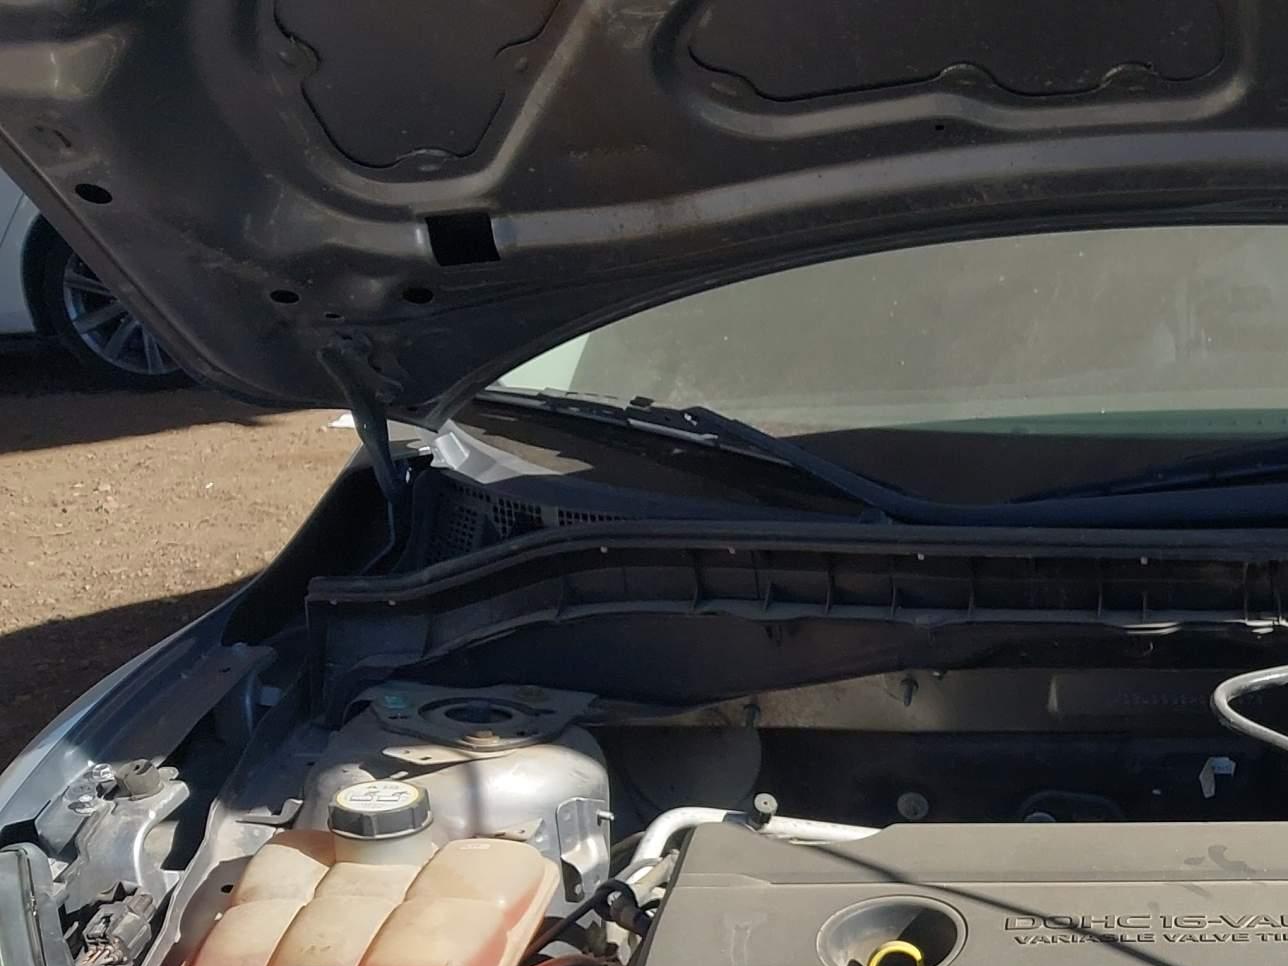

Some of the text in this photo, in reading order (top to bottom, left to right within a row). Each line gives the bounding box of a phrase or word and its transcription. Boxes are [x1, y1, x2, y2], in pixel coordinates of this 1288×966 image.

[1004, 915, 1151, 930] DOHC
[1014, 933, 1155, 944] VARIABLE
[1163, 932, 1250, 942] VALVE
